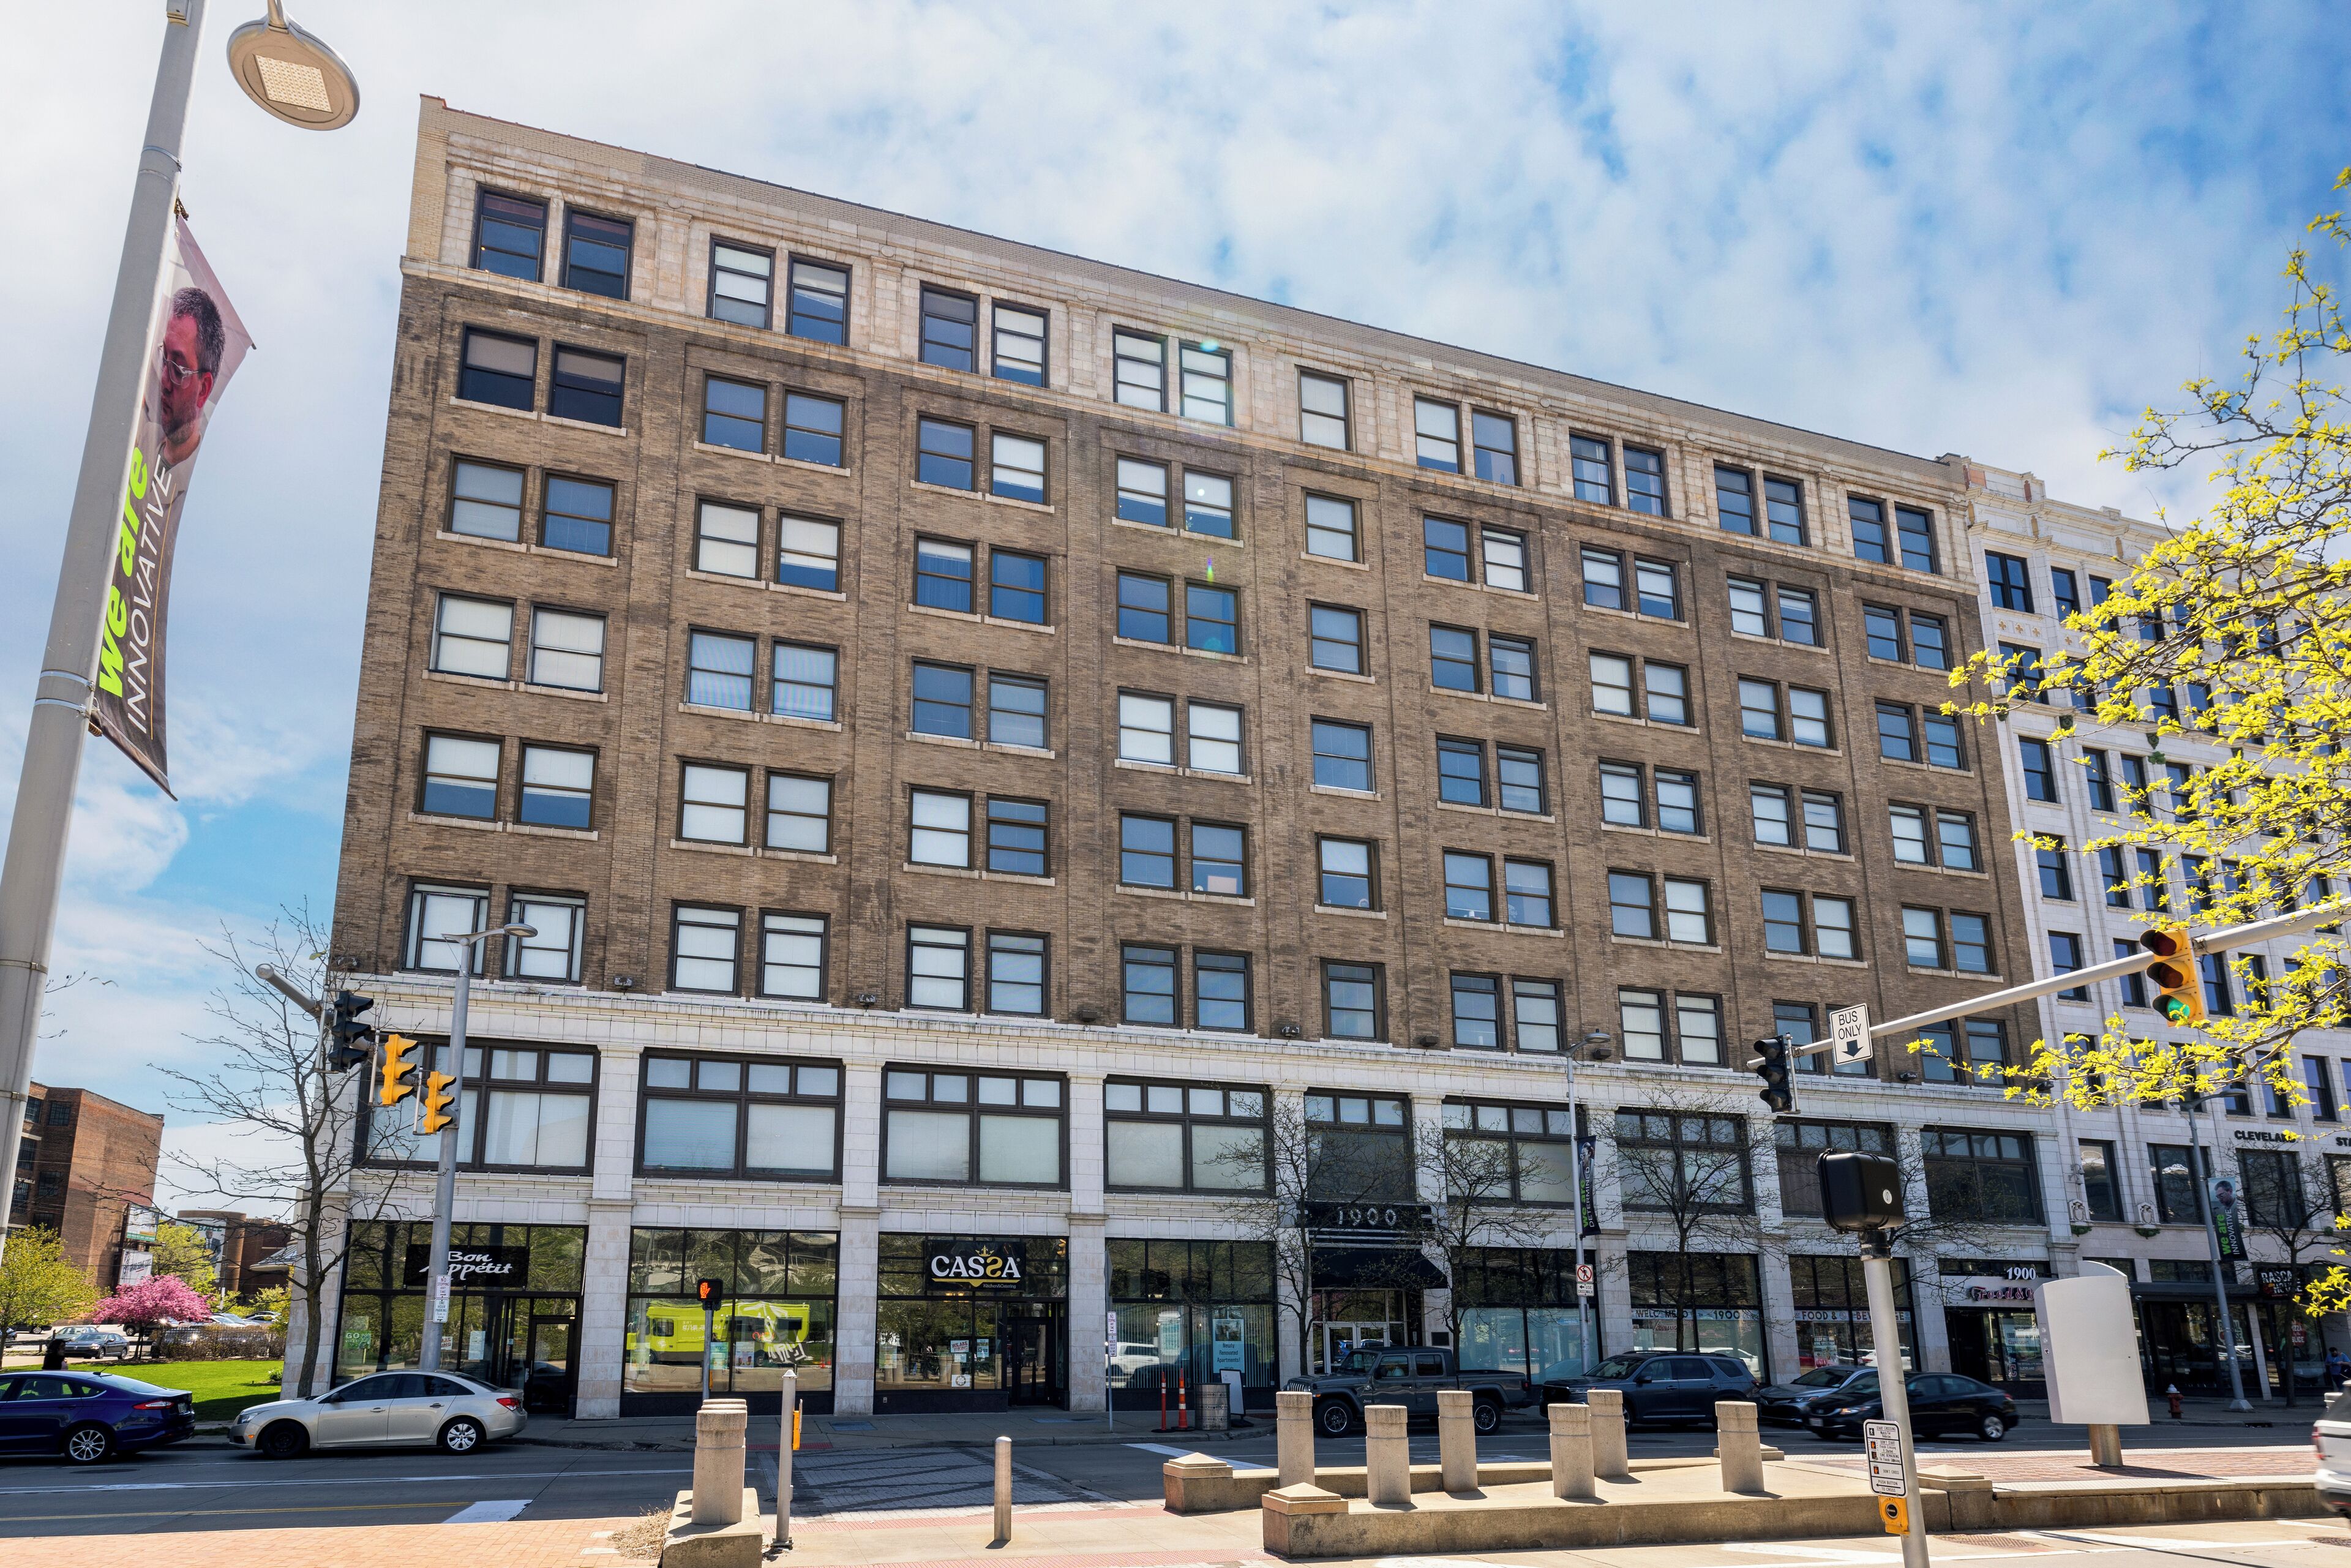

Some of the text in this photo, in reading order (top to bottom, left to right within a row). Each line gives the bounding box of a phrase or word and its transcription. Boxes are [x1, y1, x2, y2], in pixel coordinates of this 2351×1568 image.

[99, 447, 148, 697] we are
[127, 454, 172, 733] INNOVATIVE
[1839, 1010, 1858, 1026] BUS
[1838, 1023, 1861, 1040] ONLY
[1585, 1166, 1594, 1228] DETERMINED
[1338, 1207, 1397, 1226] 1900
[1581, 1207, 1589, 1228] we
[2216, 1214, 2232, 1255] we are
[2225, 1209, 2240, 1255] INNOVATIVE
[448, 1251, 492, 1262] Bon
[931, 1255, 1021, 1278] CASSA
[2006, 1267, 2036, 1280] 1900
[1972, 1286, 2014, 1301] Food
[2015, 1288, 2024, 1300] &
[1714, 1310, 1740, 1319] 1900
[1802, 1311, 1828, 1320] FOOD
[1831, 1311, 1837, 1319] &
